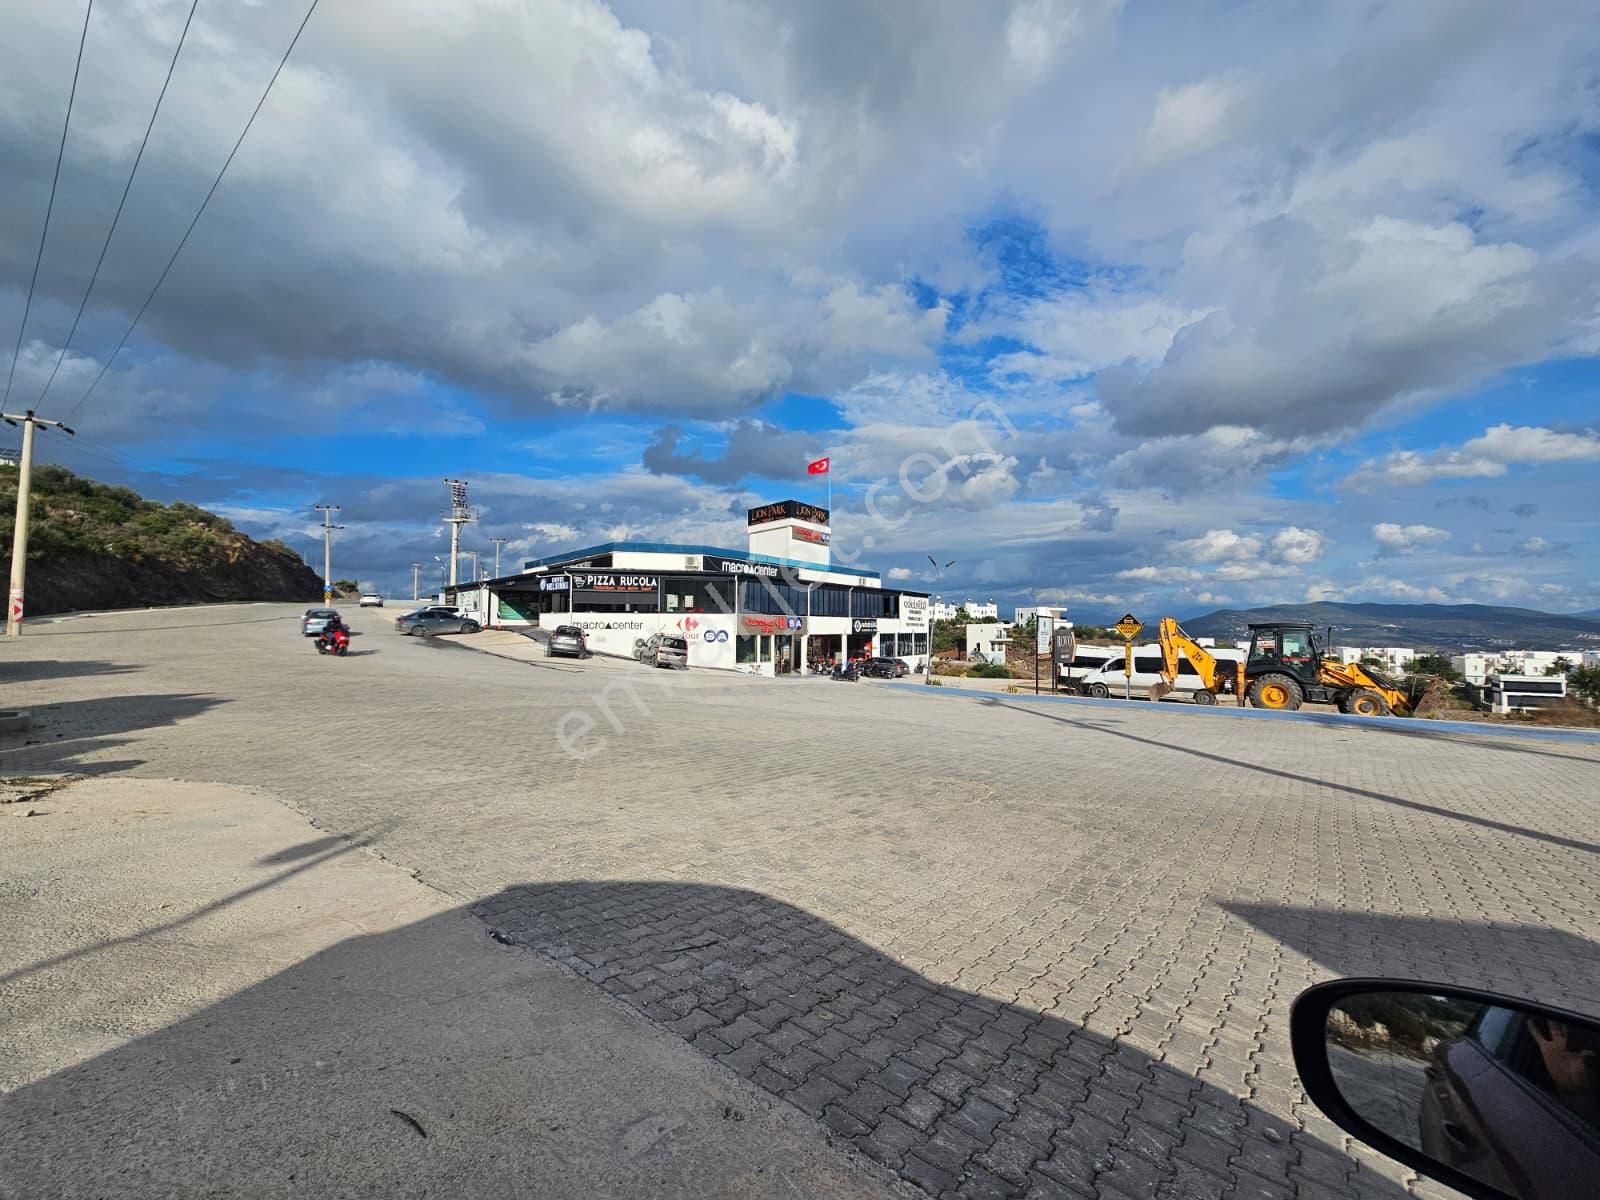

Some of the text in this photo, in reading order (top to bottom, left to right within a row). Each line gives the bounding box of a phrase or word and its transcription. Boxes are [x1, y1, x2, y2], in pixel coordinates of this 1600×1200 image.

[767, 504, 785, 517] PARK
[587, 575, 658, 587] PIZZA RUCOLA
